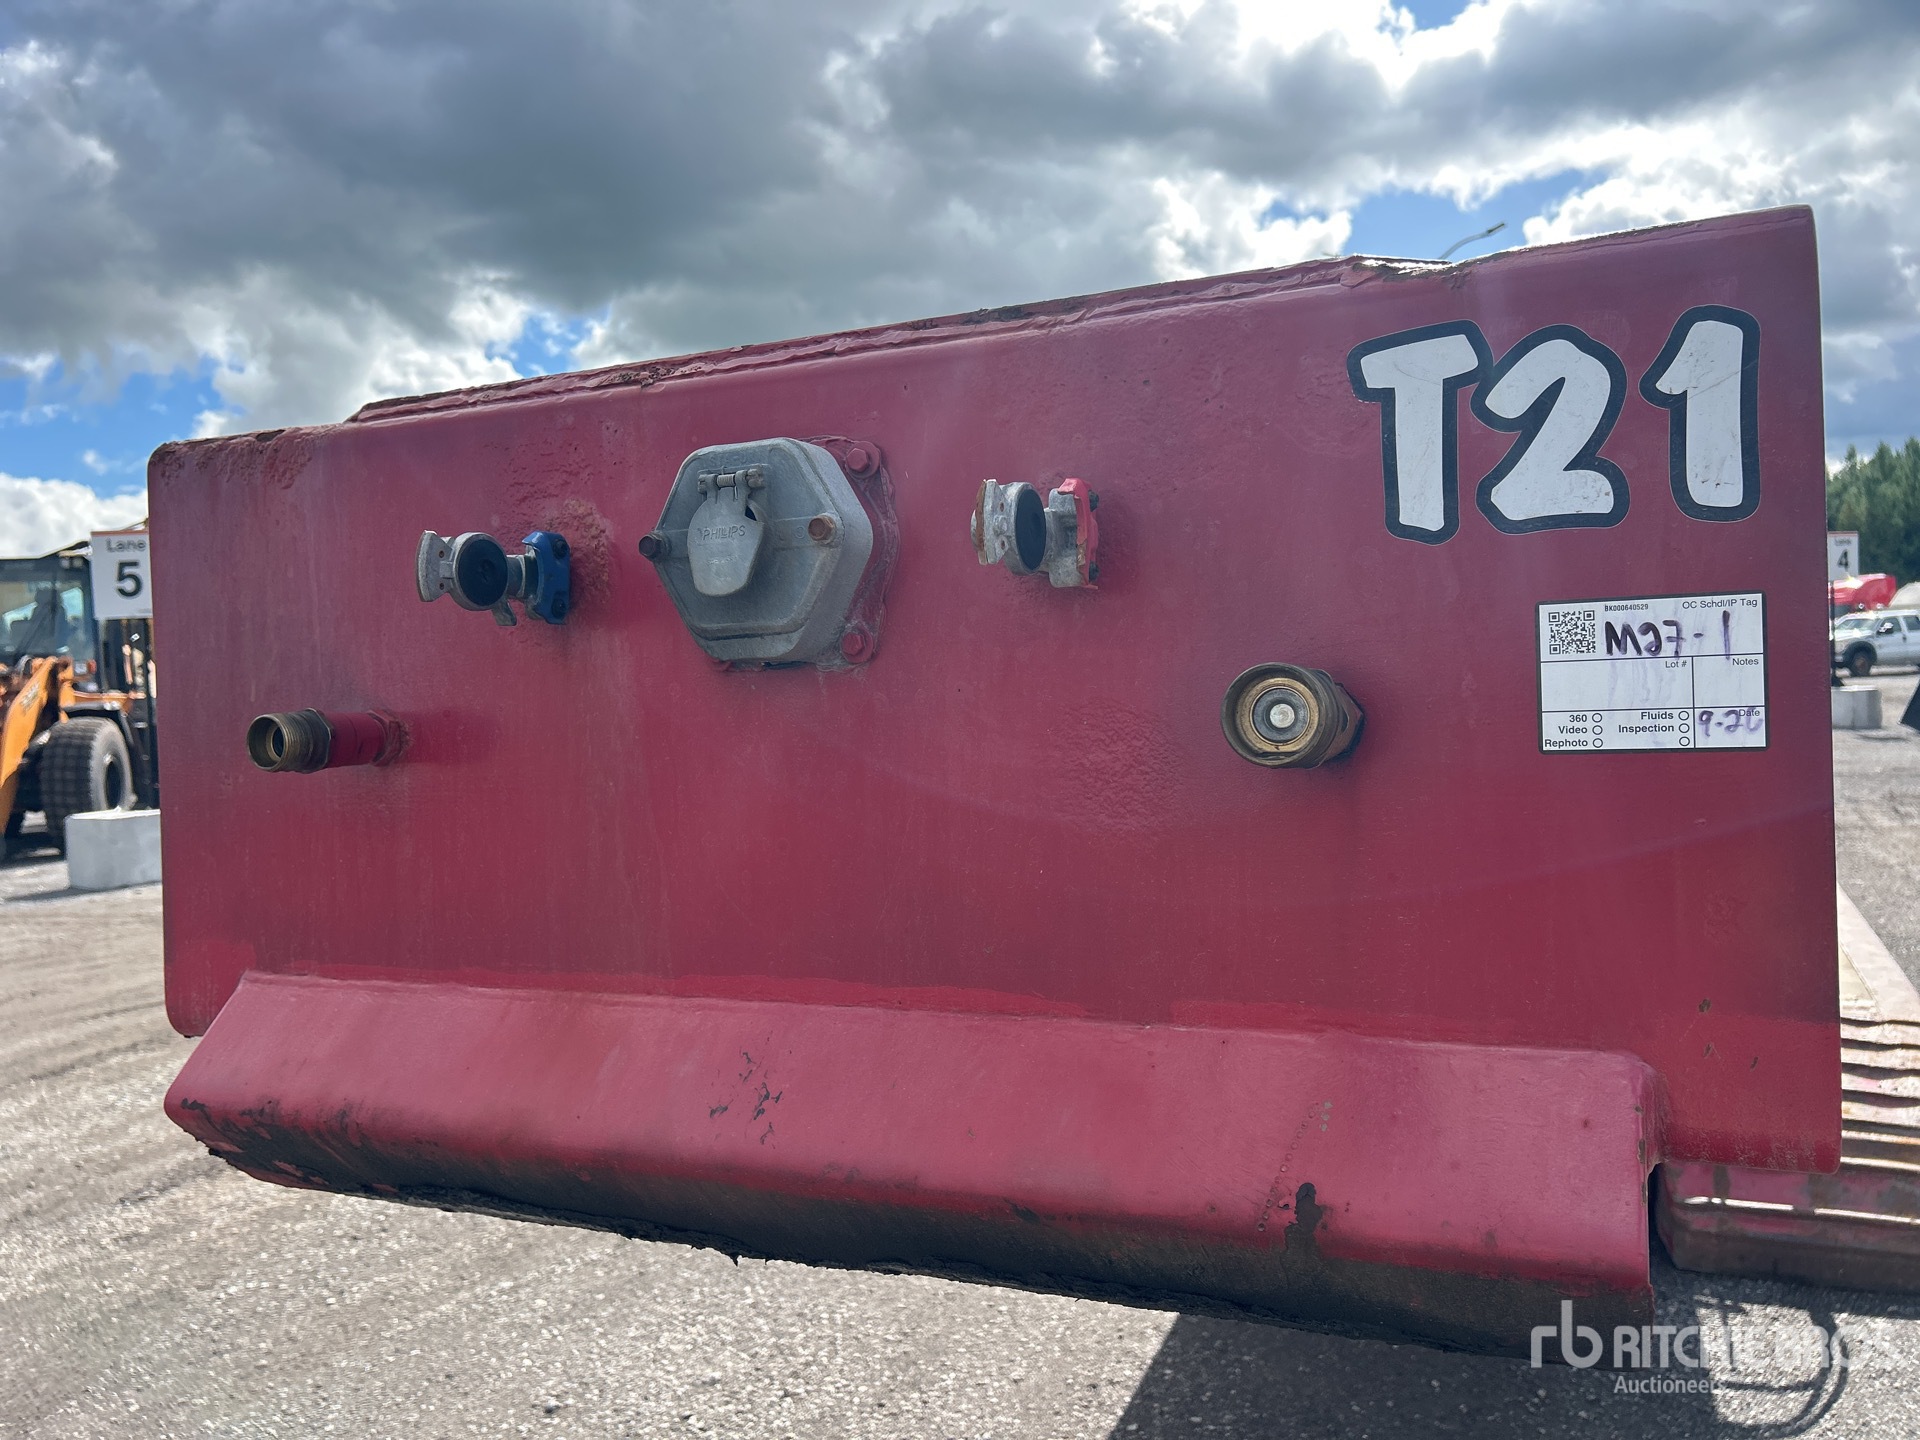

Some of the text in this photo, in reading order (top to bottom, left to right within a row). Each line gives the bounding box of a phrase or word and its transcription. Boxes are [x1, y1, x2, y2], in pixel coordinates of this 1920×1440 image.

[1347, 304, 1761, 546] T21
[703, 524, 746, 540] PHILLIPS
[106, 538, 146, 552] Lane
[1837, 549, 1850, 571] 4
[117, 561, 142, 597] 5
[1604, 603, 1649, 612] BK000640529
[1682, 600, 1698, 609] OC
[1740, 598, 1758, 607] Tag
[1665, 660, 1679, 669] Lot
[1732, 658, 1759, 666] Notes
[1640, 711, 1674, 720] Fluids
[1738, 709, 1760, 717] Date
[1569, 714, 1588, 723] 360
[1558, 725, 1588, 734] Video
[1618, 724, 1675, 735] Inspection
[1544, 739, 1588, 749] Rephoto
